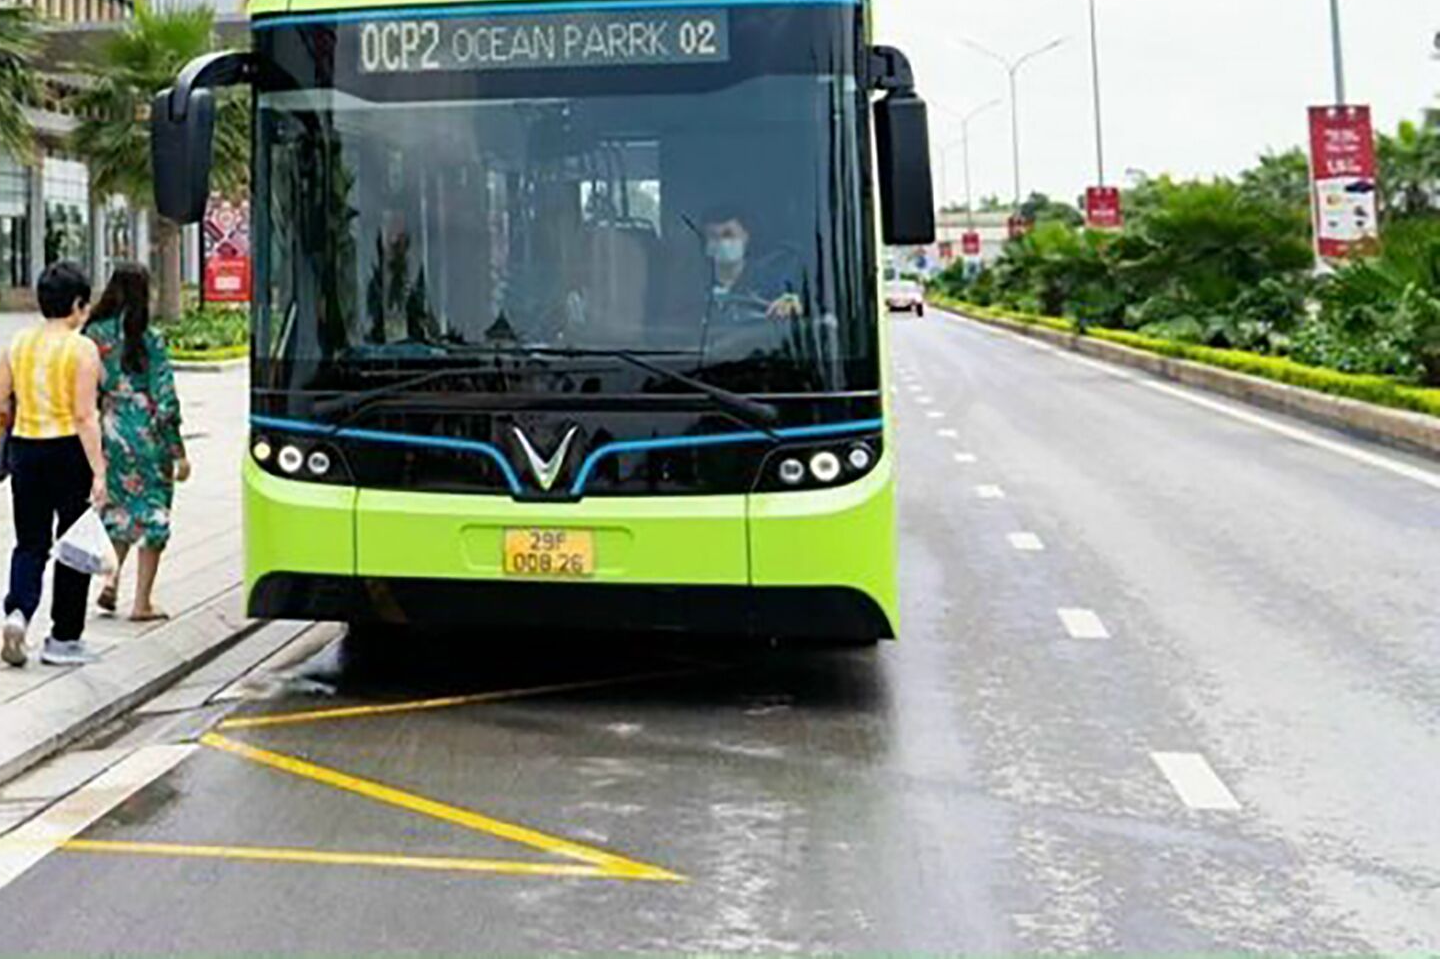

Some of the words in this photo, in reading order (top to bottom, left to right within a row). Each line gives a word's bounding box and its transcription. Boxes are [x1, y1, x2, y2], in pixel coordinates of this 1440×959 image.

[452, 23, 557, 62] OCEAN
[564, 21, 668, 59] PARRK
[678, 19, 716, 55] 02
